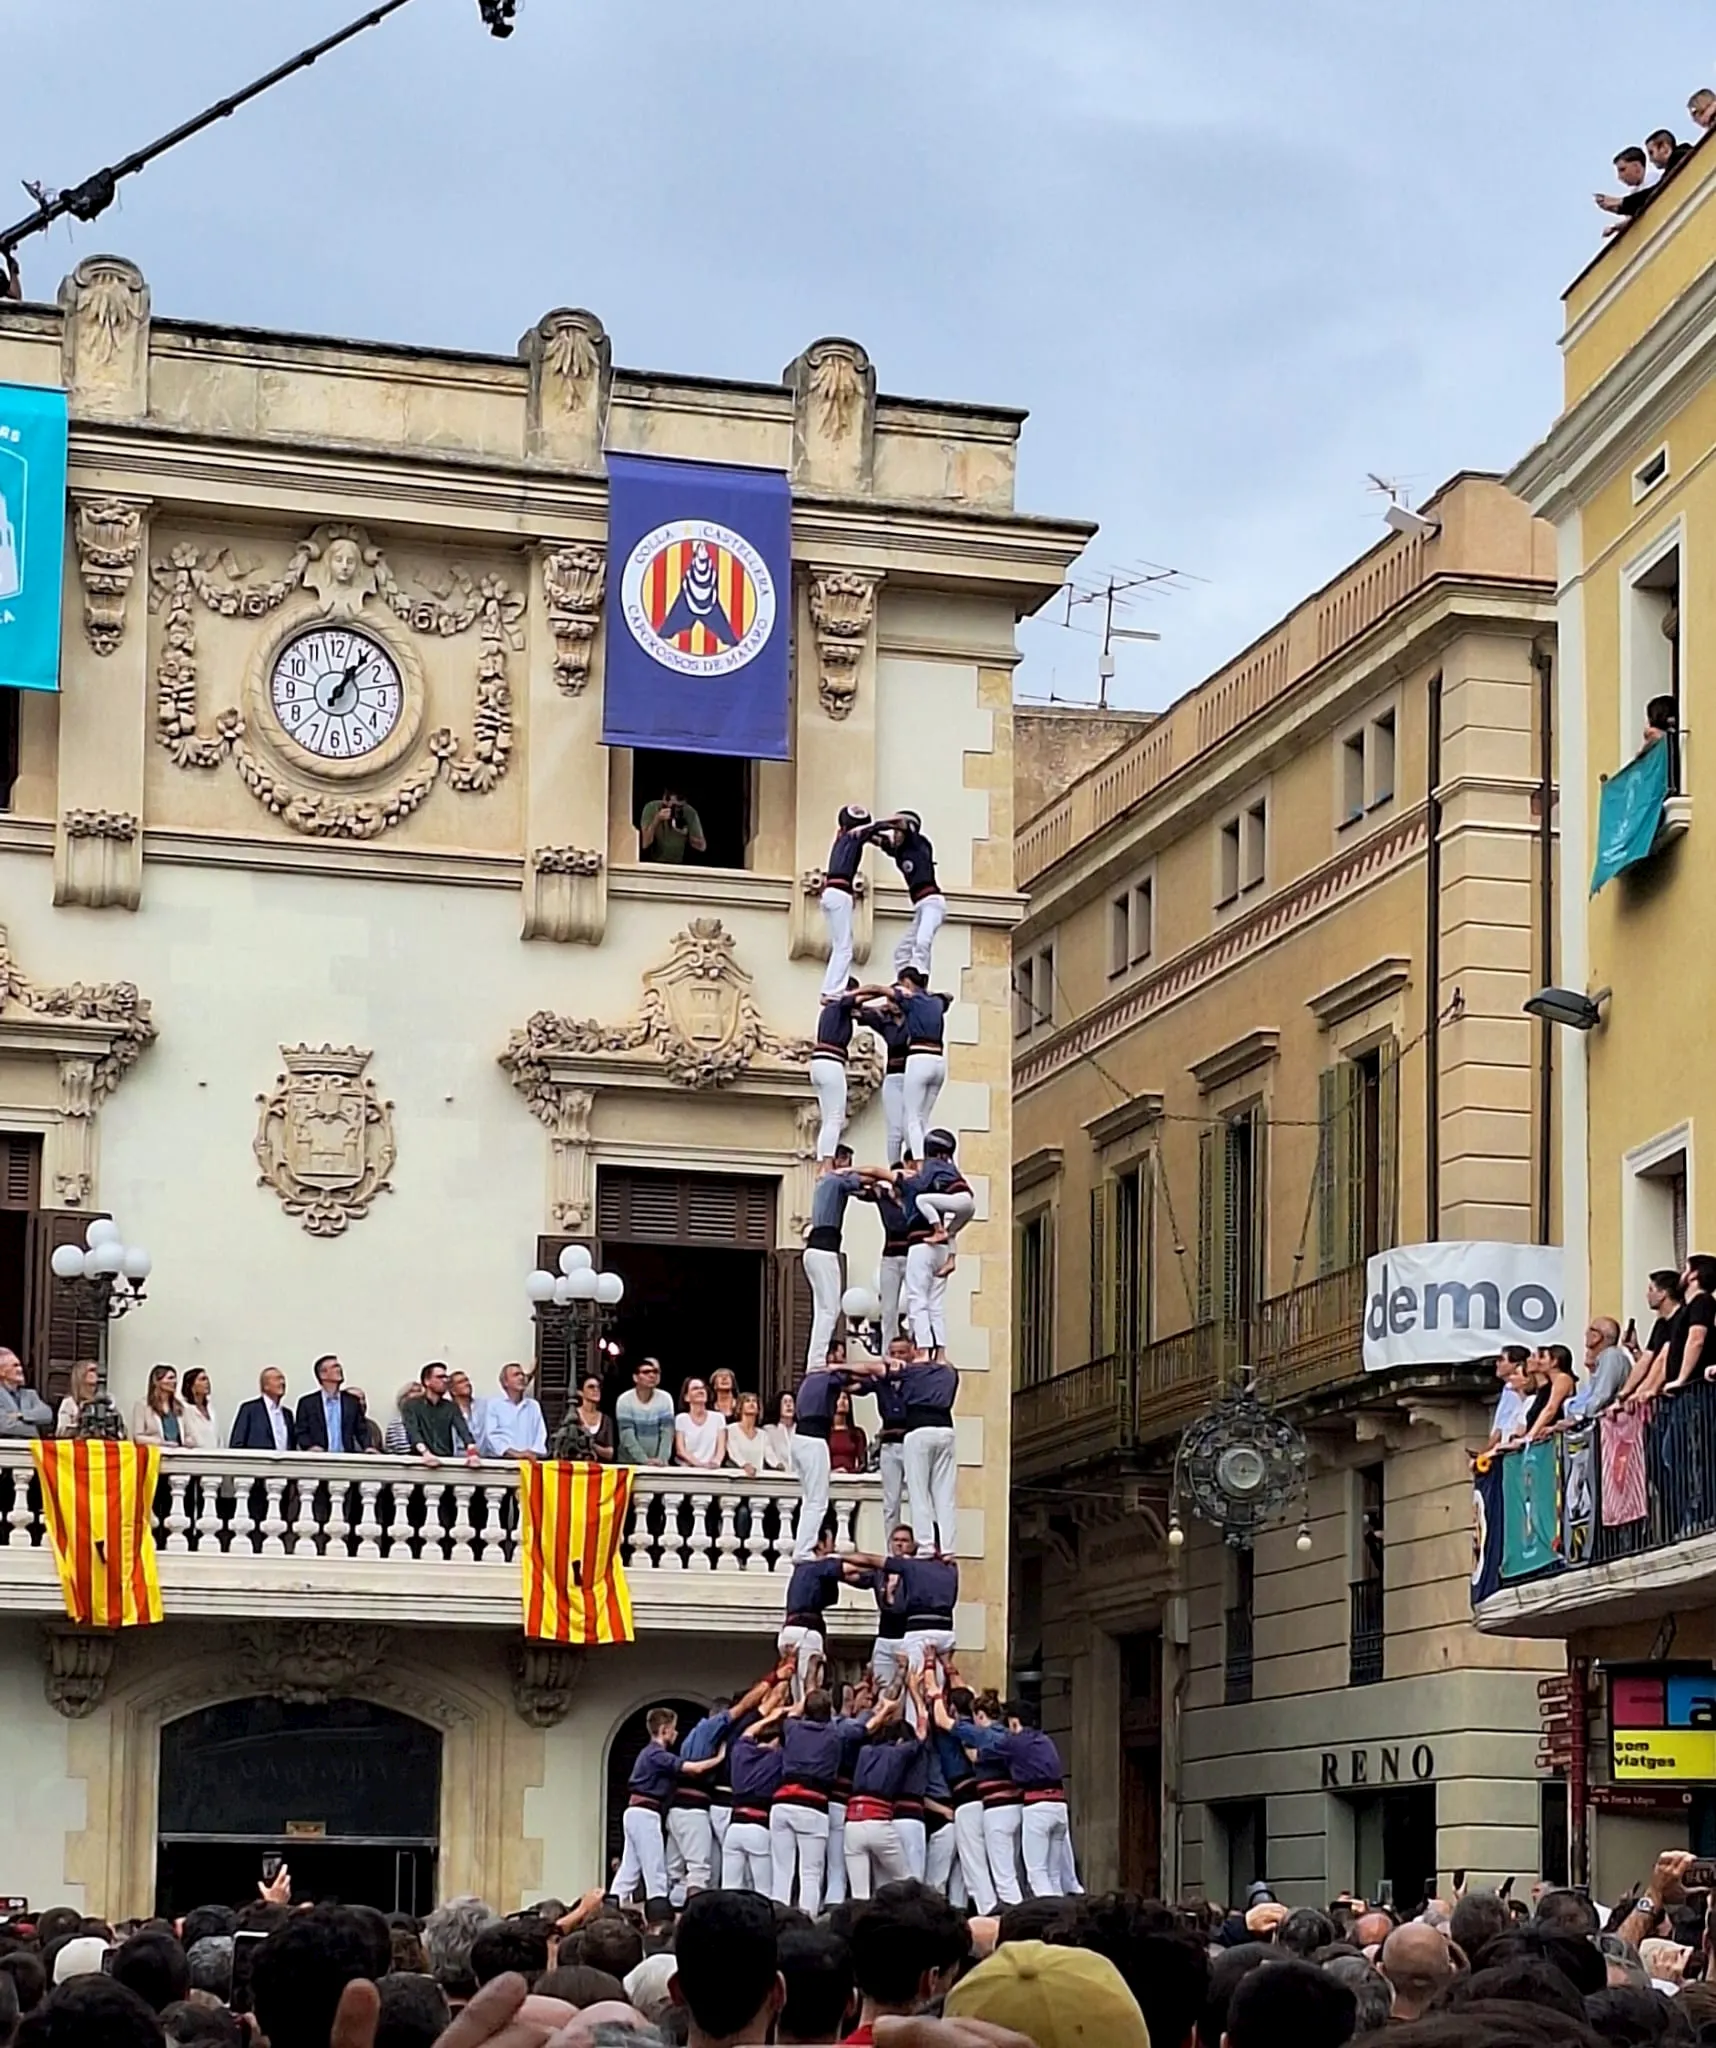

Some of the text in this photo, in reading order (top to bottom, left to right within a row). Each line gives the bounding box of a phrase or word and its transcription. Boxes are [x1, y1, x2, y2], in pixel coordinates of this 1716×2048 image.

[634, 528, 675, 564] COLLA
[308, 643, 319, 662] 11
[331, 639, 345, 659] 12
[291, 658, 306, 677] 10
[371, 664, 382, 684] 2
[703, 660, 723, 672] DE
[376, 689, 387, 708] 3
[291, 704, 301, 722] 8
[368, 711, 378, 729] 4
[309, 723, 320, 743] 7
[329, 730, 341, 749] 6
[352, 727, 363, 746] 5
[1367, 1262, 1564, 1341] demo
[1614, 1742, 1650, 1752] som
[1320, 1744, 1434, 1787] RENO
[1614, 1754, 1676, 1770] viatges
